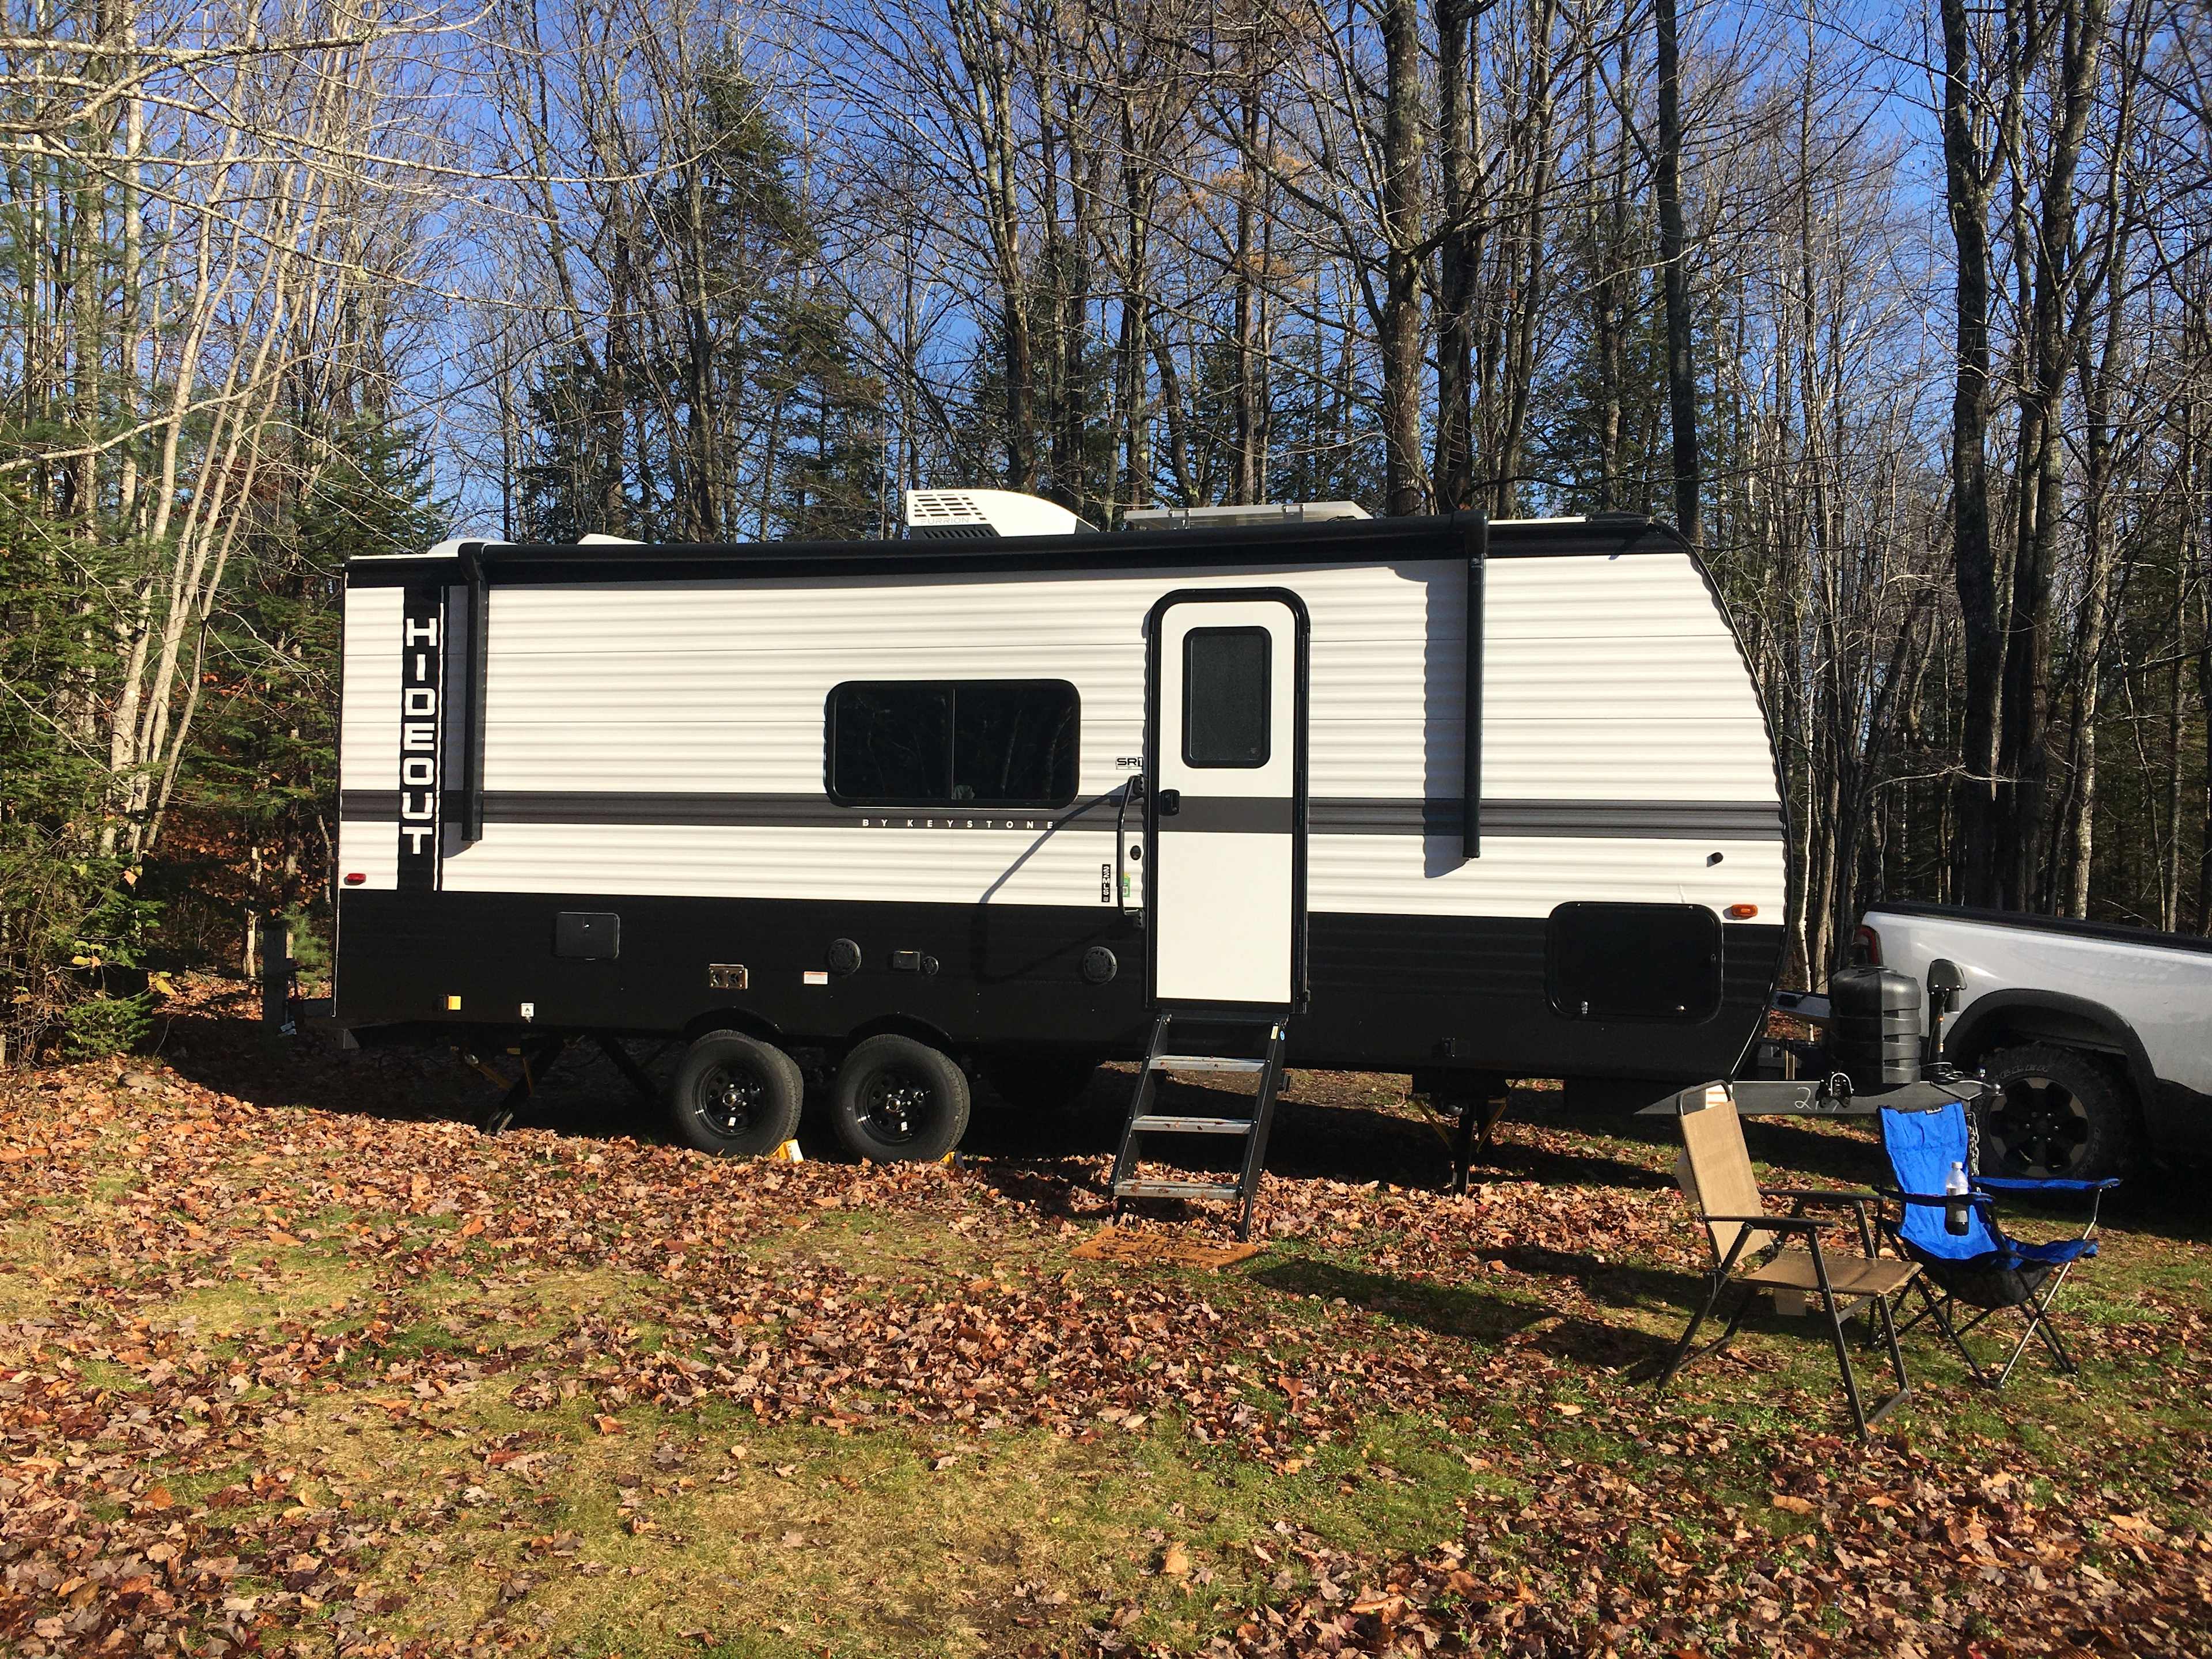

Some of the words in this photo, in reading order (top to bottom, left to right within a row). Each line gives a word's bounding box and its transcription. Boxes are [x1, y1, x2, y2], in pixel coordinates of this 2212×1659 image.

[402, 618, 438, 855] HIDEOUT
[907, 820, 1053, 829] KEYSTONE
[1102, 866, 1111, 896] 22MLS
